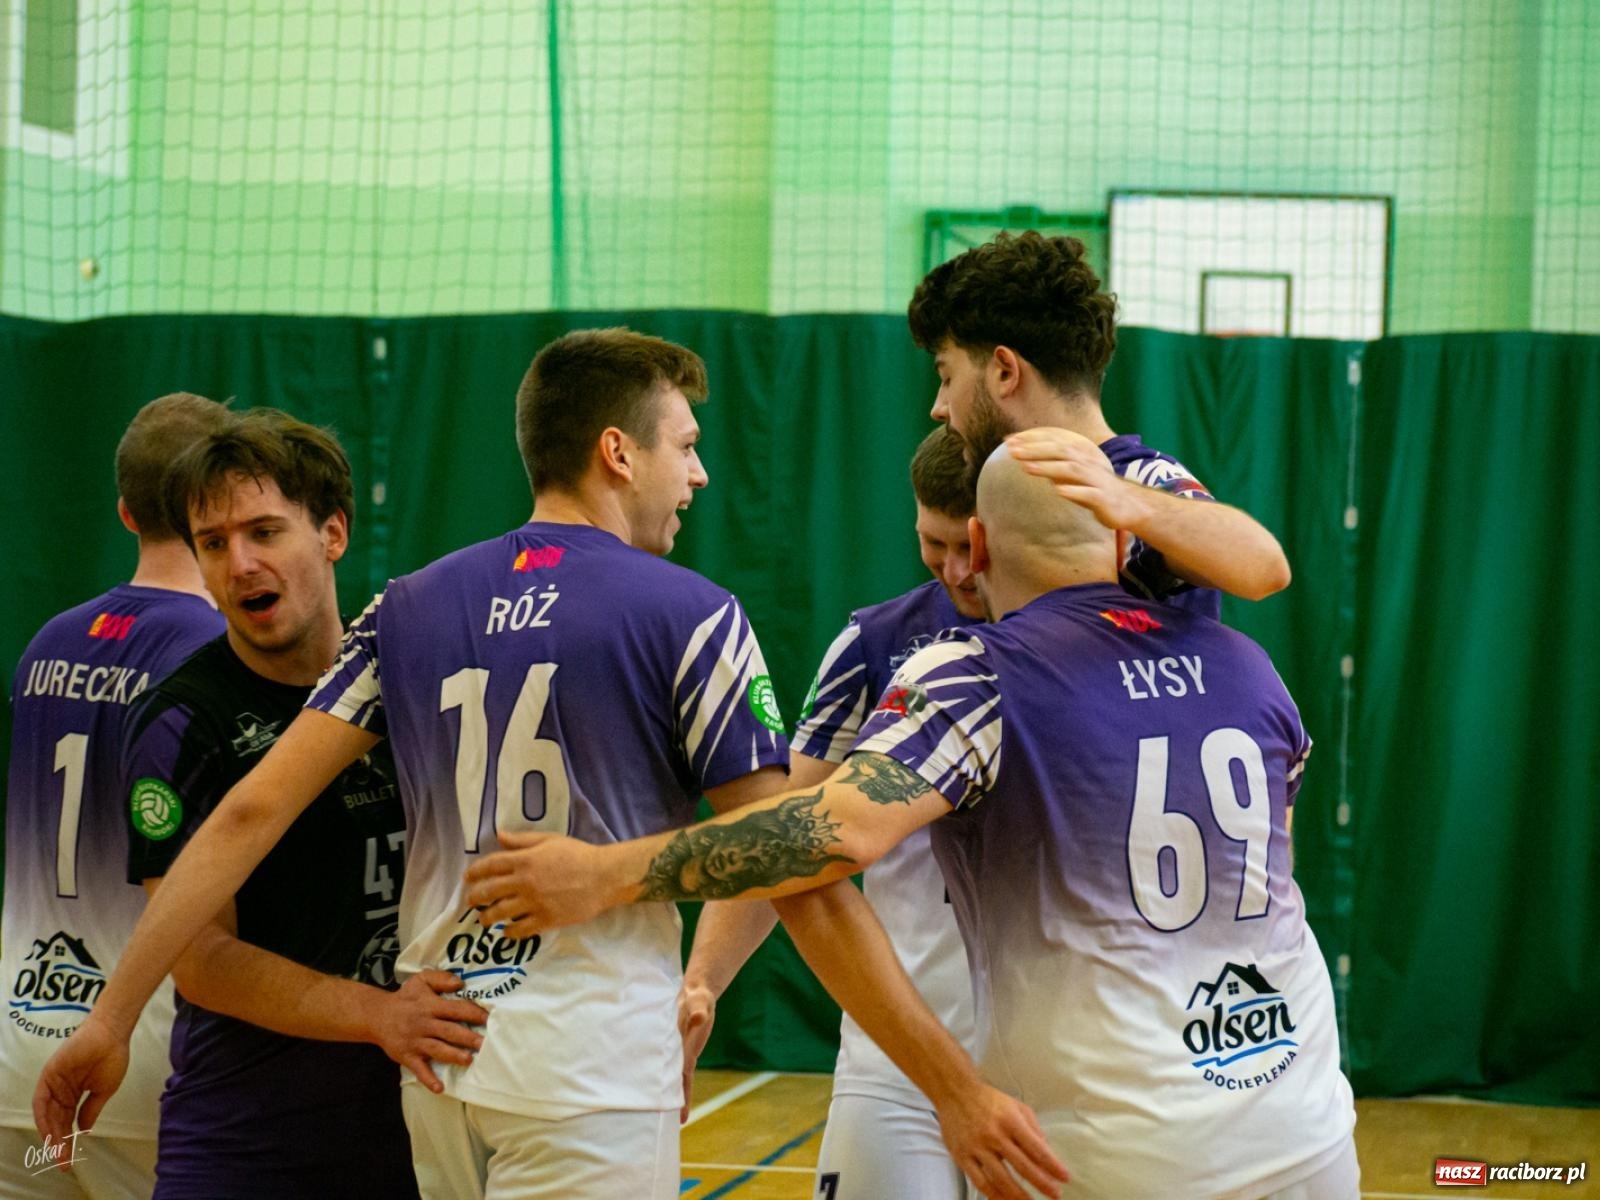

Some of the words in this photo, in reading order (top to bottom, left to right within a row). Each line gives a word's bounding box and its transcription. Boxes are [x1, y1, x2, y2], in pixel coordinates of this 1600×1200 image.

[485, 584, 560, 635] RÓŻ
[23, 659, 150, 706] JURECZKA
[1118, 655, 1207, 701] ŁYSY
[440, 662, 571, 854] 16
[53, 732, 89, 898] 1
[1126, 727, 1272, 934] 69
[14, 960, 107, 1005] olsen
[9, 1010, 77, 1039] DOCIEPLE
[1183, 1001, 1297, 1055] olsen
[1203, 1050, 1298, 1091] DOCIEPLENIA
